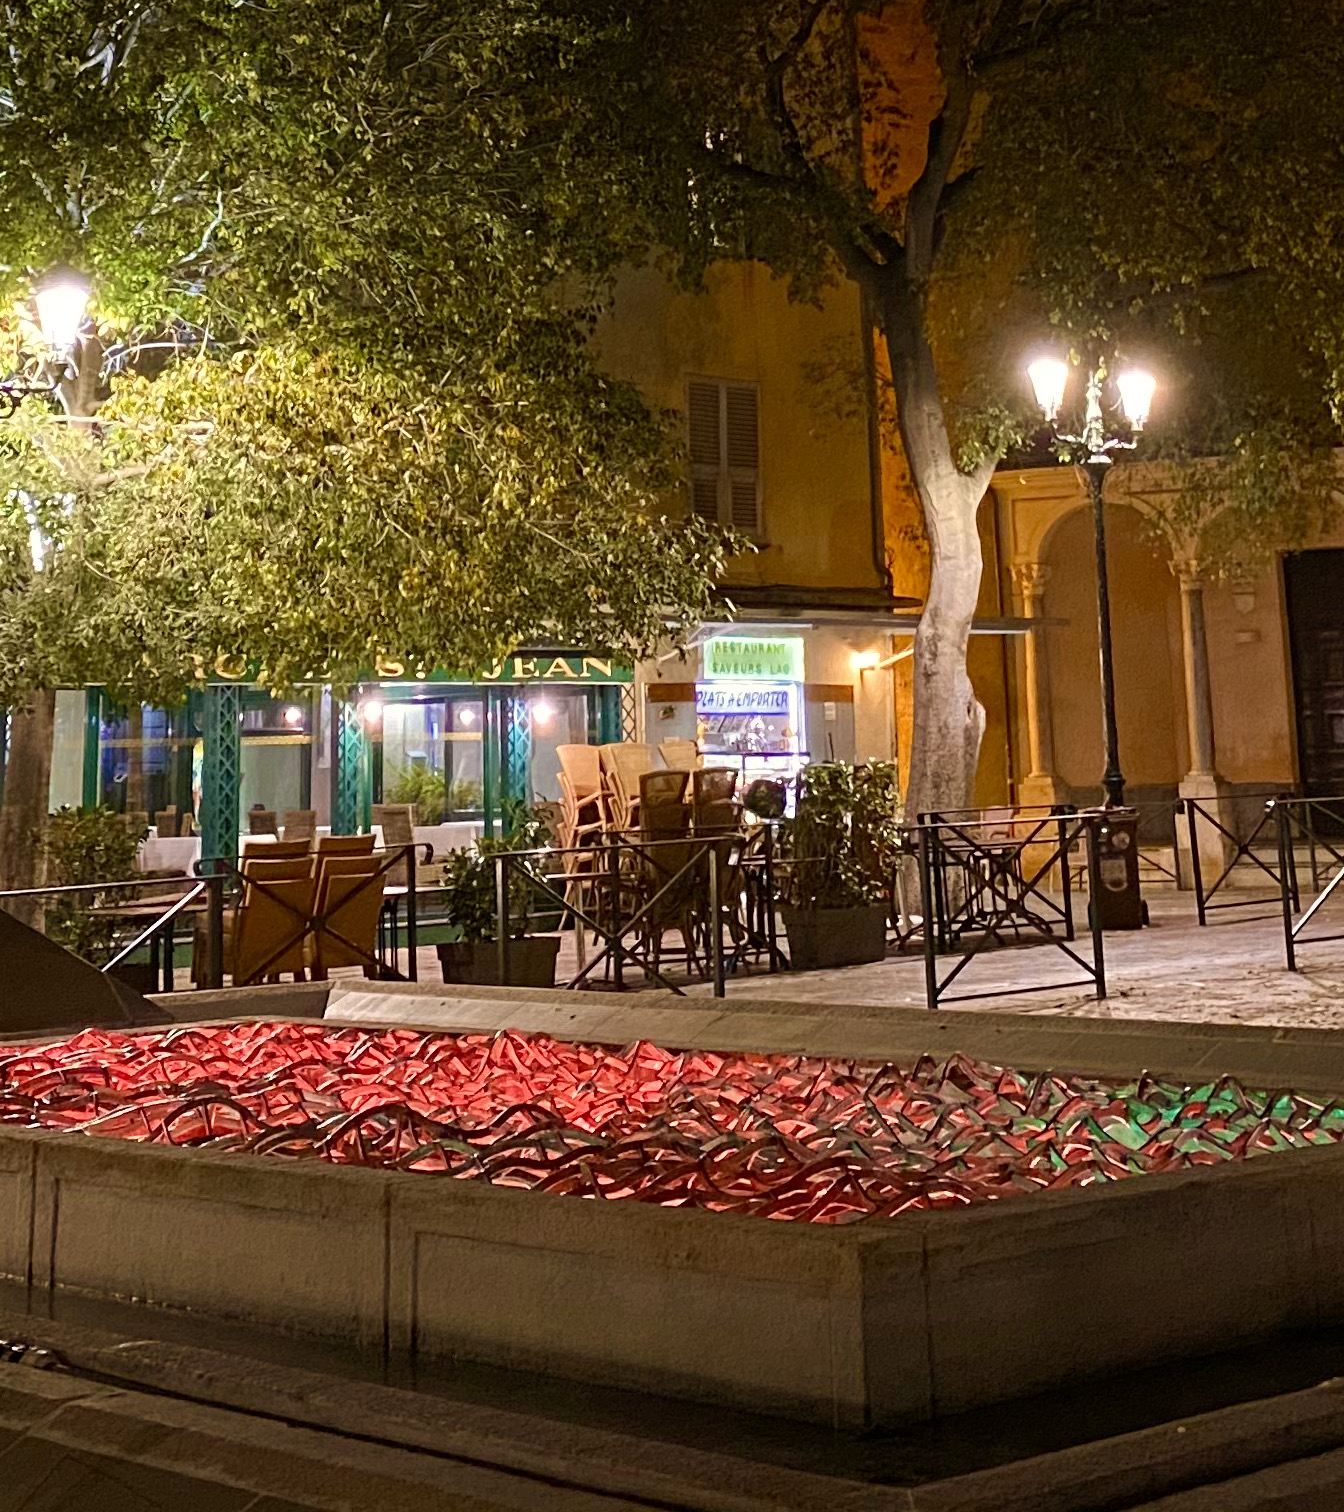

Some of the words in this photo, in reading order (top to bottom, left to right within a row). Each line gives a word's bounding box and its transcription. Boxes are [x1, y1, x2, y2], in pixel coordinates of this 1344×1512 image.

[714, 641, 786, 655] RESTAURANT
[482, 656, 613, 680] JEAN
[712, 662, 762, 675] SAVEURS
[769, 663, 790, 676] LAO
[697, 690, 725, 708] PLATS
[736, 690, 788, 708] EMPORTER
